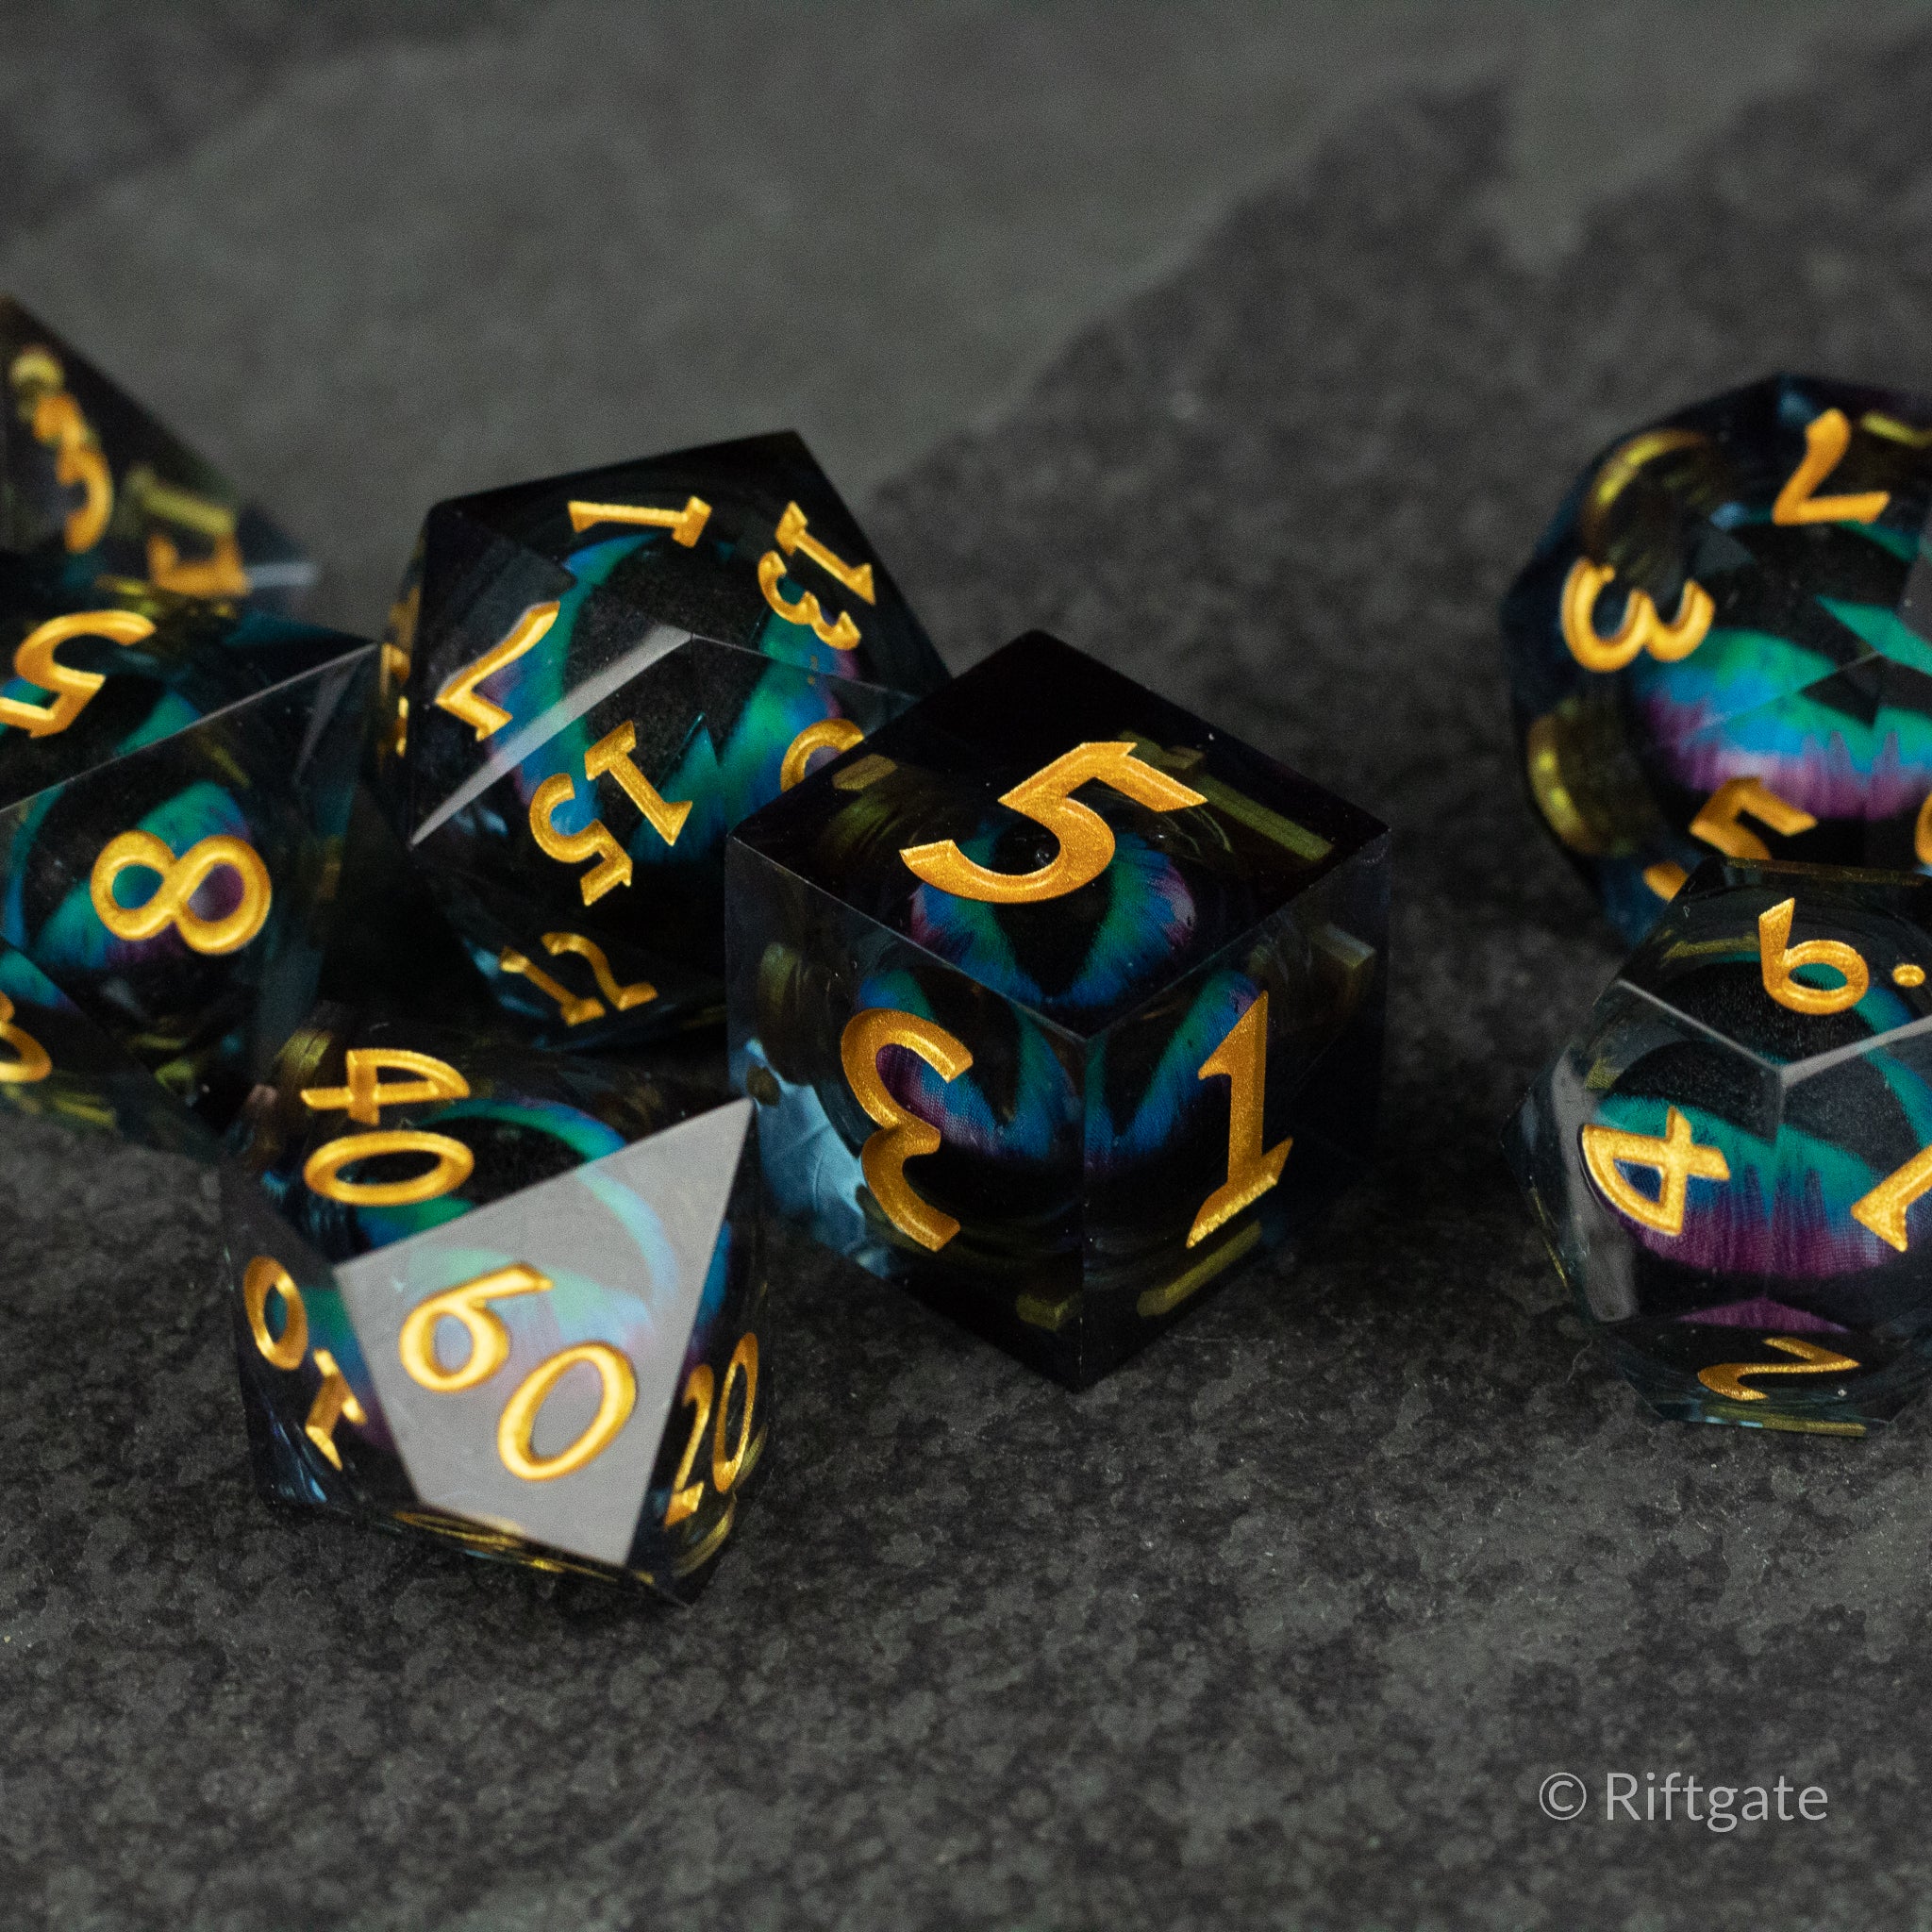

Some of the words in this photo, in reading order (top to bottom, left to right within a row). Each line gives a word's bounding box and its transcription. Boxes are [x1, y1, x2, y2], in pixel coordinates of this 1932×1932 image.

[568, 496, 712, 548] 1
[757, 501, 876, 651] 13
[0, 609, 157, 739] 5
[436, 599, 561, 741] 7
[1560, 557, 1716, 673] 3
[529, 721, 693, 907] 15
[899, 741, 1208, 905] 5
[90, 830, 273, 956] 8
[498, 931, 658, 1026] 12
[300, 1047, 475, 1208] 40
[841, 1008, 974, 1253] 3
[1186, 991, 1293, 1249] 1
[1582, 1106, 1730, 1238] 4
[399, 1262, 640, 1482] 60
[663, 1331, 760, 1528] 20
